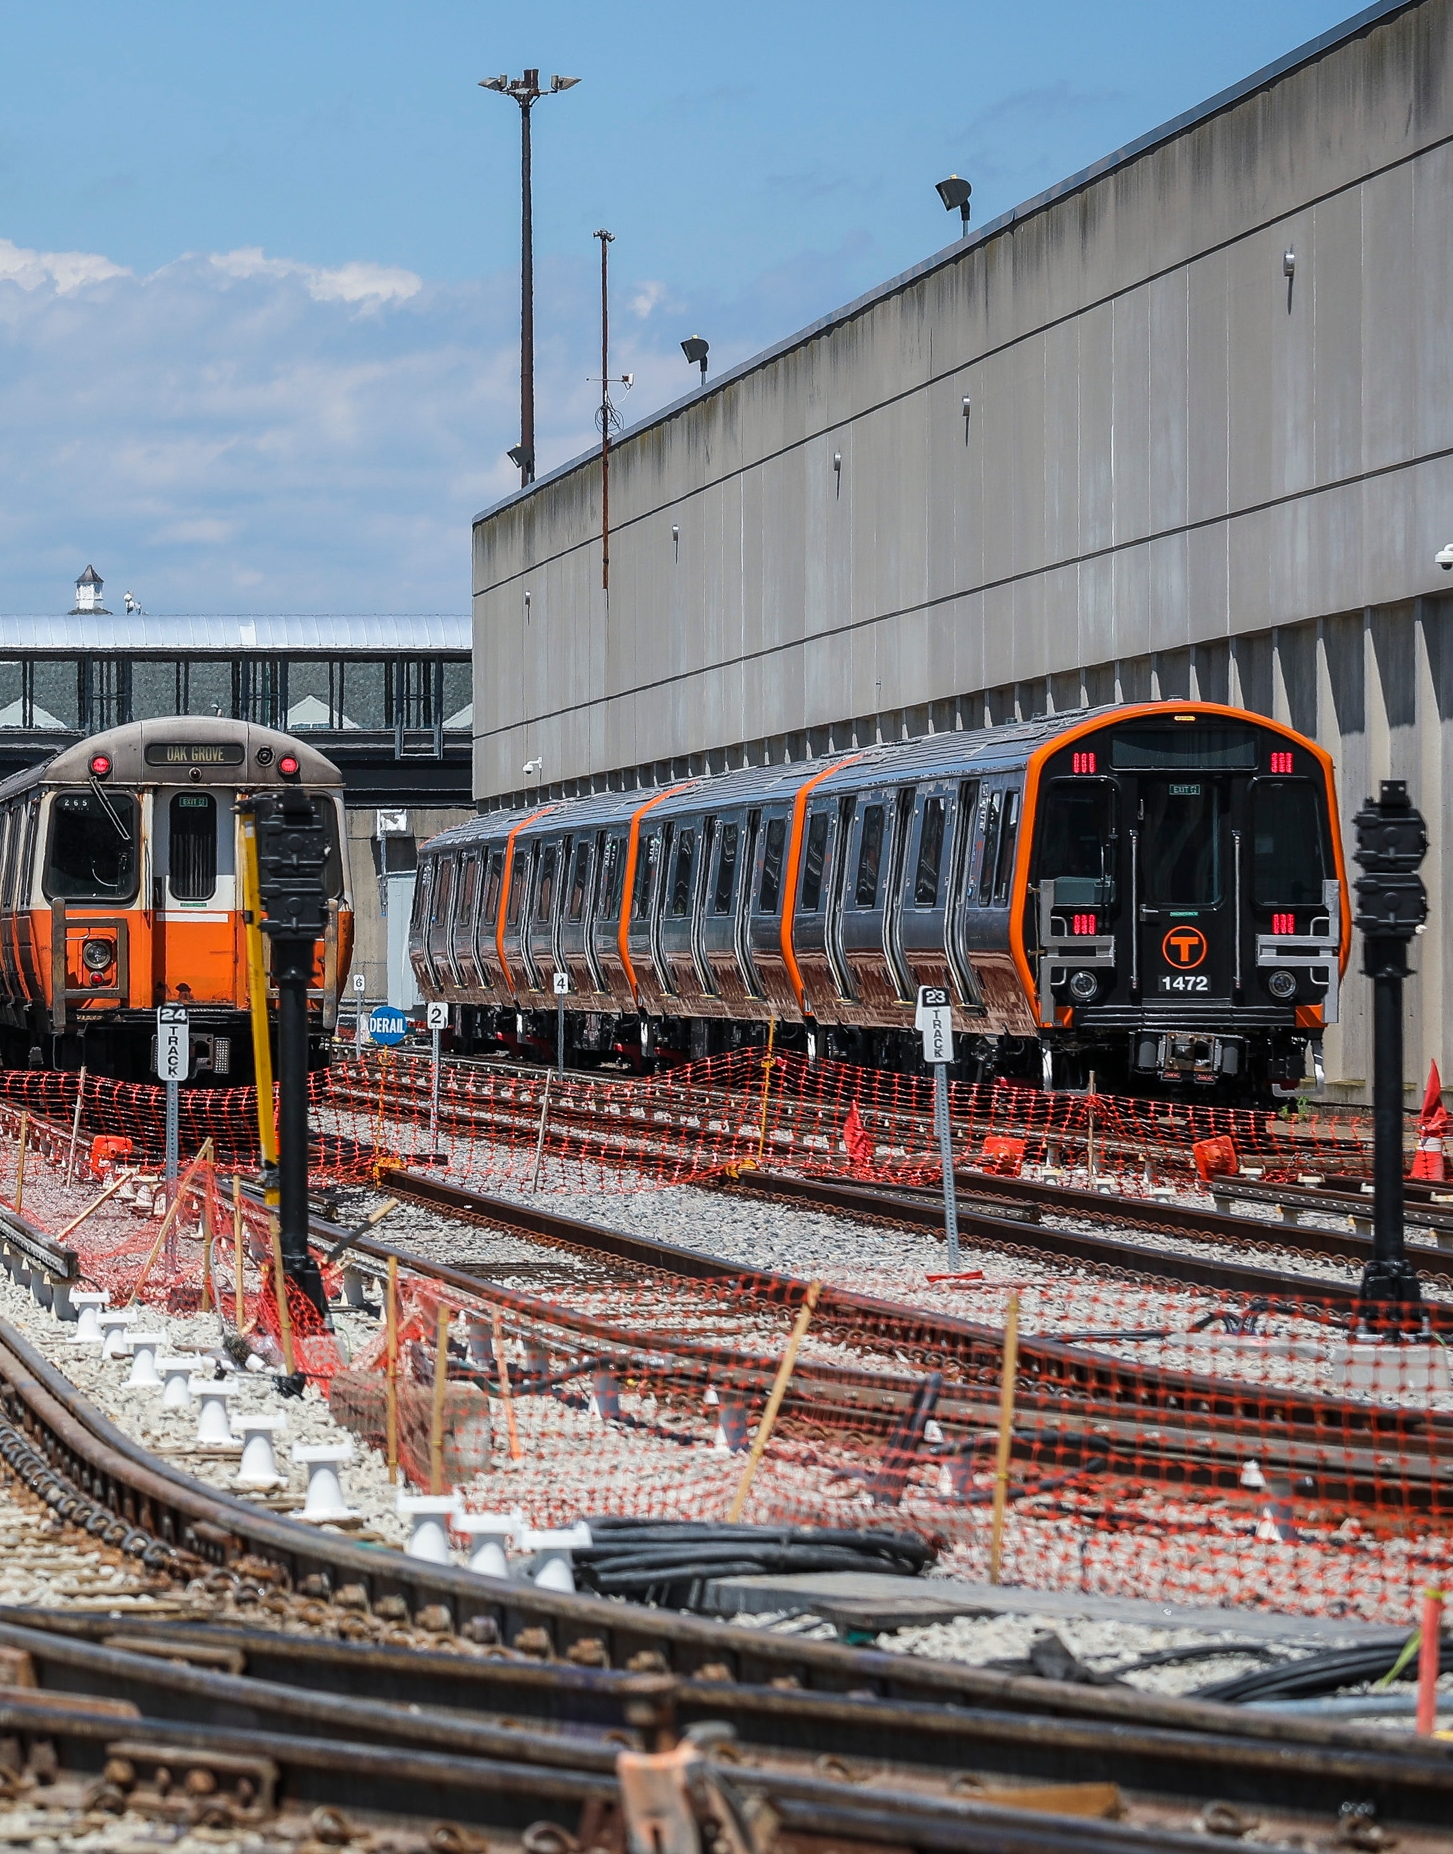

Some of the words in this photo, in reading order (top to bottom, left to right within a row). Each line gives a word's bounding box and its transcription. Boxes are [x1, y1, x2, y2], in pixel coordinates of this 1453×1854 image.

[167, 746, 187, 761] OAK
[191, 746, 225, 761] GROVE
[1170, 937, 1199, 962] T
[356, 977, 363, 987] 6
[556, 978, 566, 990] 4
[1162, 976, 1208, 991] 1472
[925, 990, 946, 1004] 23
[161, 1008, 187, 1021] 24
[430, 1008, 442, 1024] 2
[369, 1017, 406, 1034] DERAIL
[932, 1010, 944, 1059] TRACK
[167, 1026, 179, 1076] TRACK
